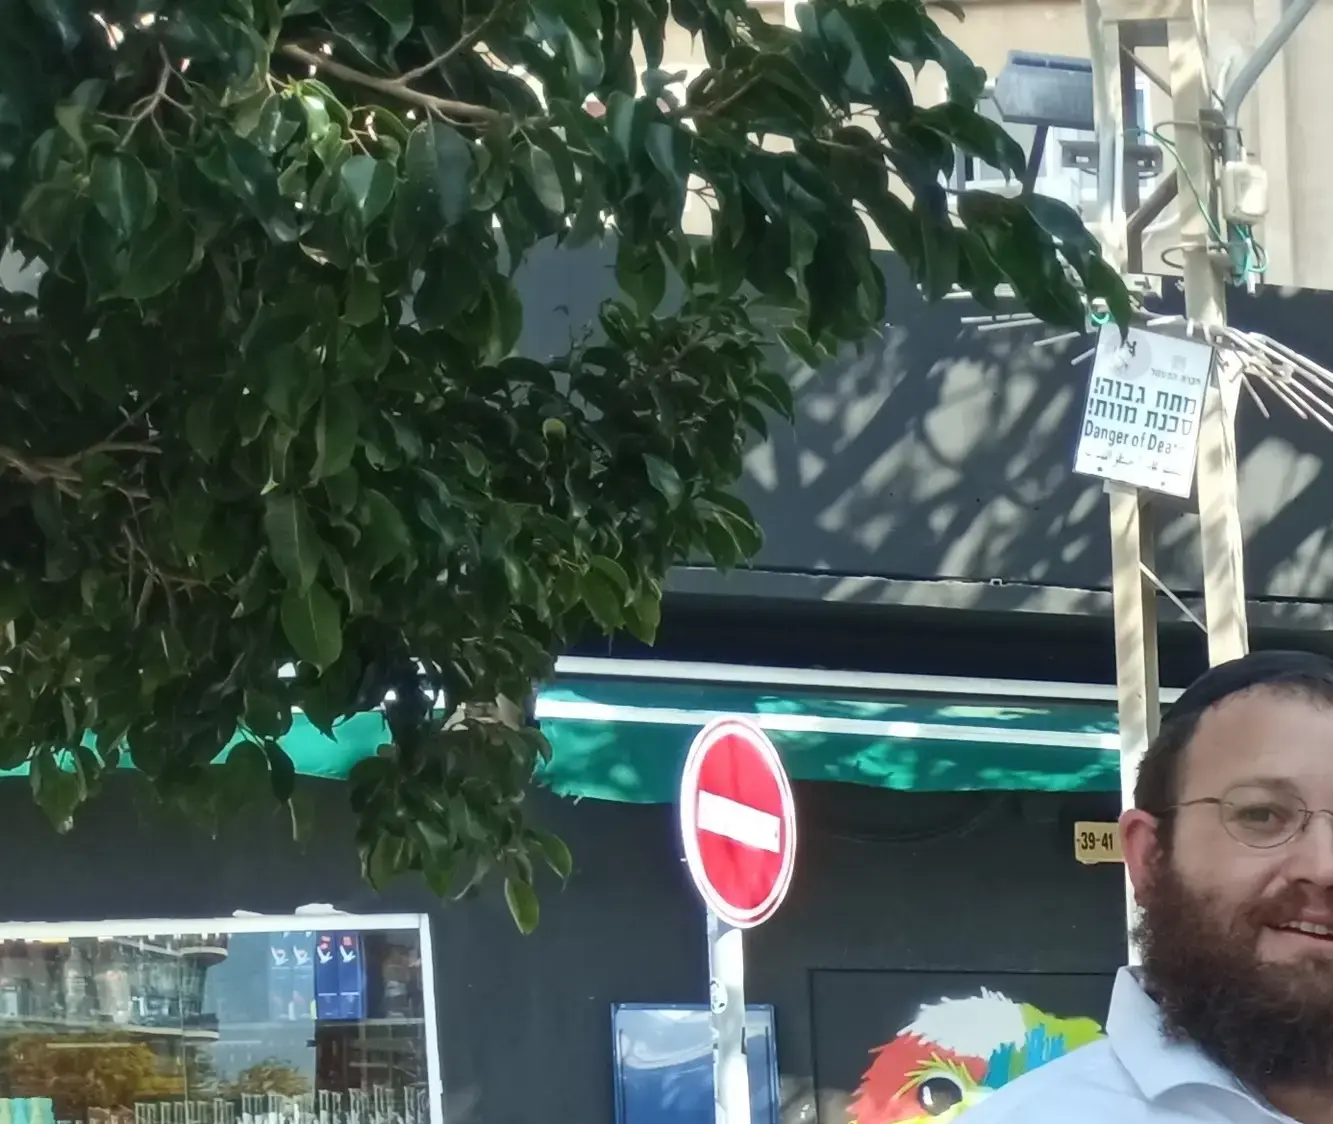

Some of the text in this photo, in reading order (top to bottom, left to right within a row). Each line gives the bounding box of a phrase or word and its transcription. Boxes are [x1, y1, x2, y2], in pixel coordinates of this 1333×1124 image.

[1093, 376, 1197, 416] מתח גבוה!
[1087, 397, 1193, 436] סכנת מוות!
[1084, 419, 1186, 455] Danger of Dea
